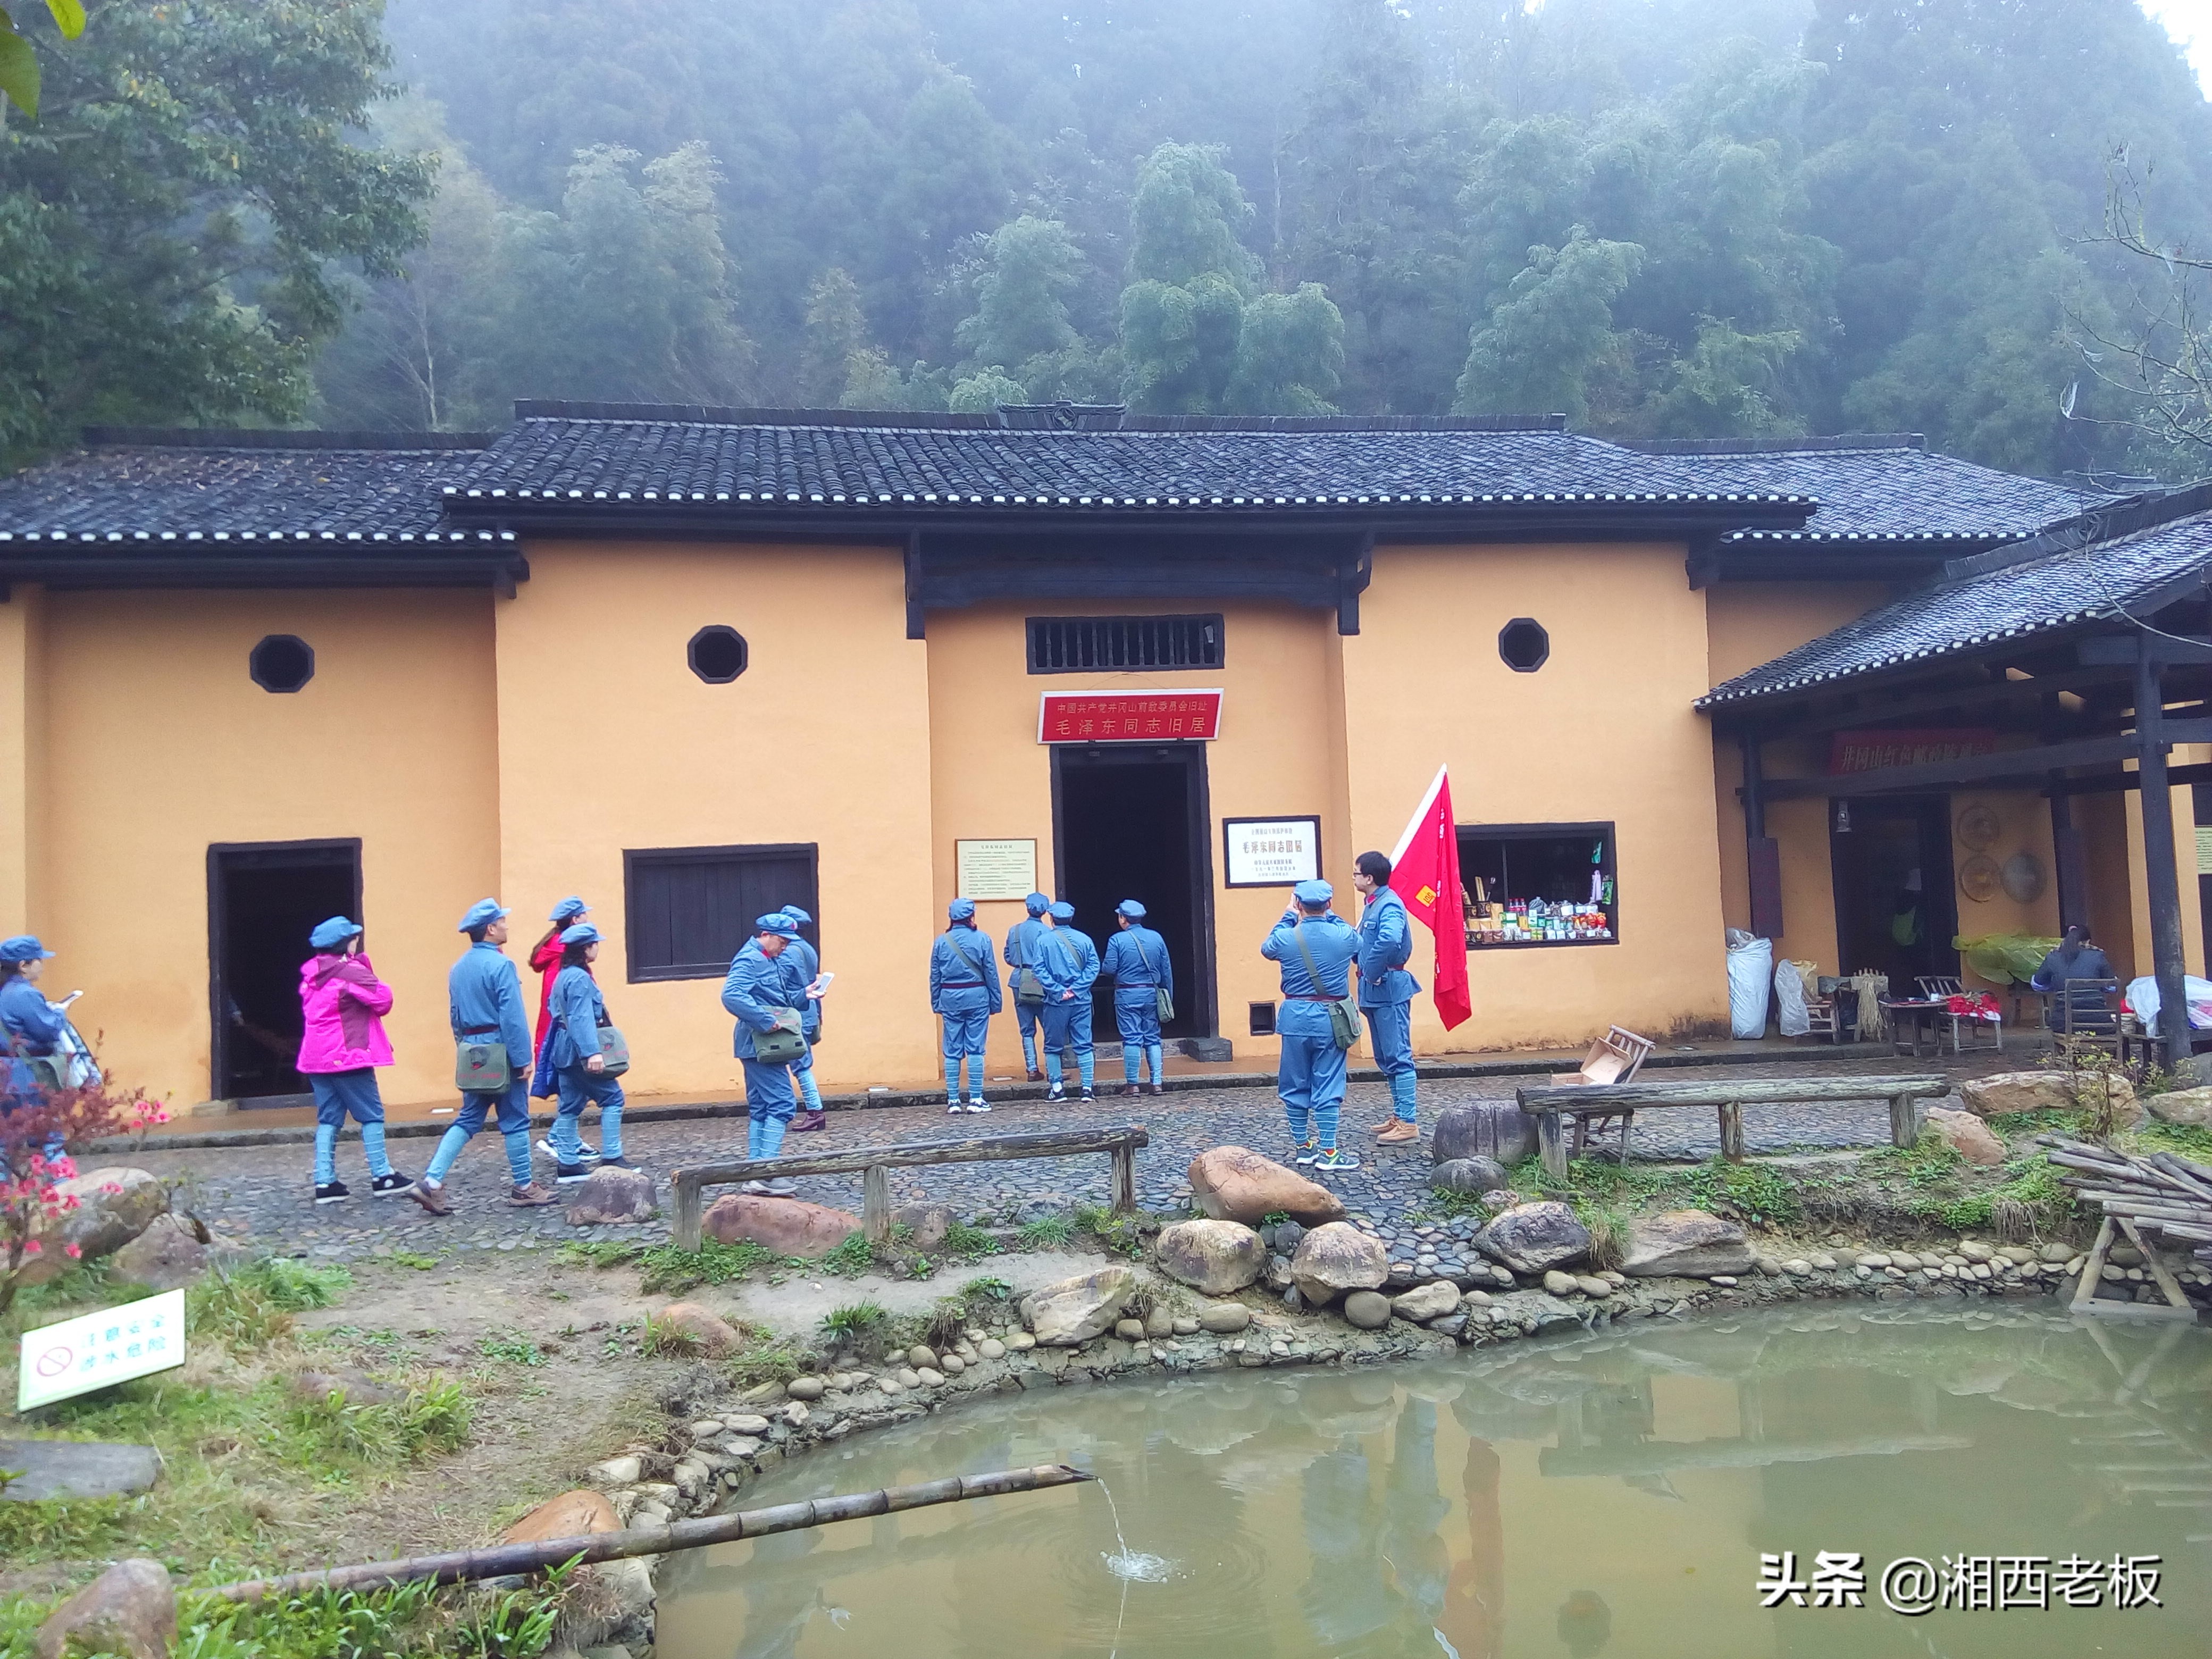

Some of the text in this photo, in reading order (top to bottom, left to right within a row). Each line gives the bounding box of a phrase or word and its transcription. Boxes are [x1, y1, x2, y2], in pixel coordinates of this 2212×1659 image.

[1055, 717, 1206, 735] 毛泽东同志旧居
